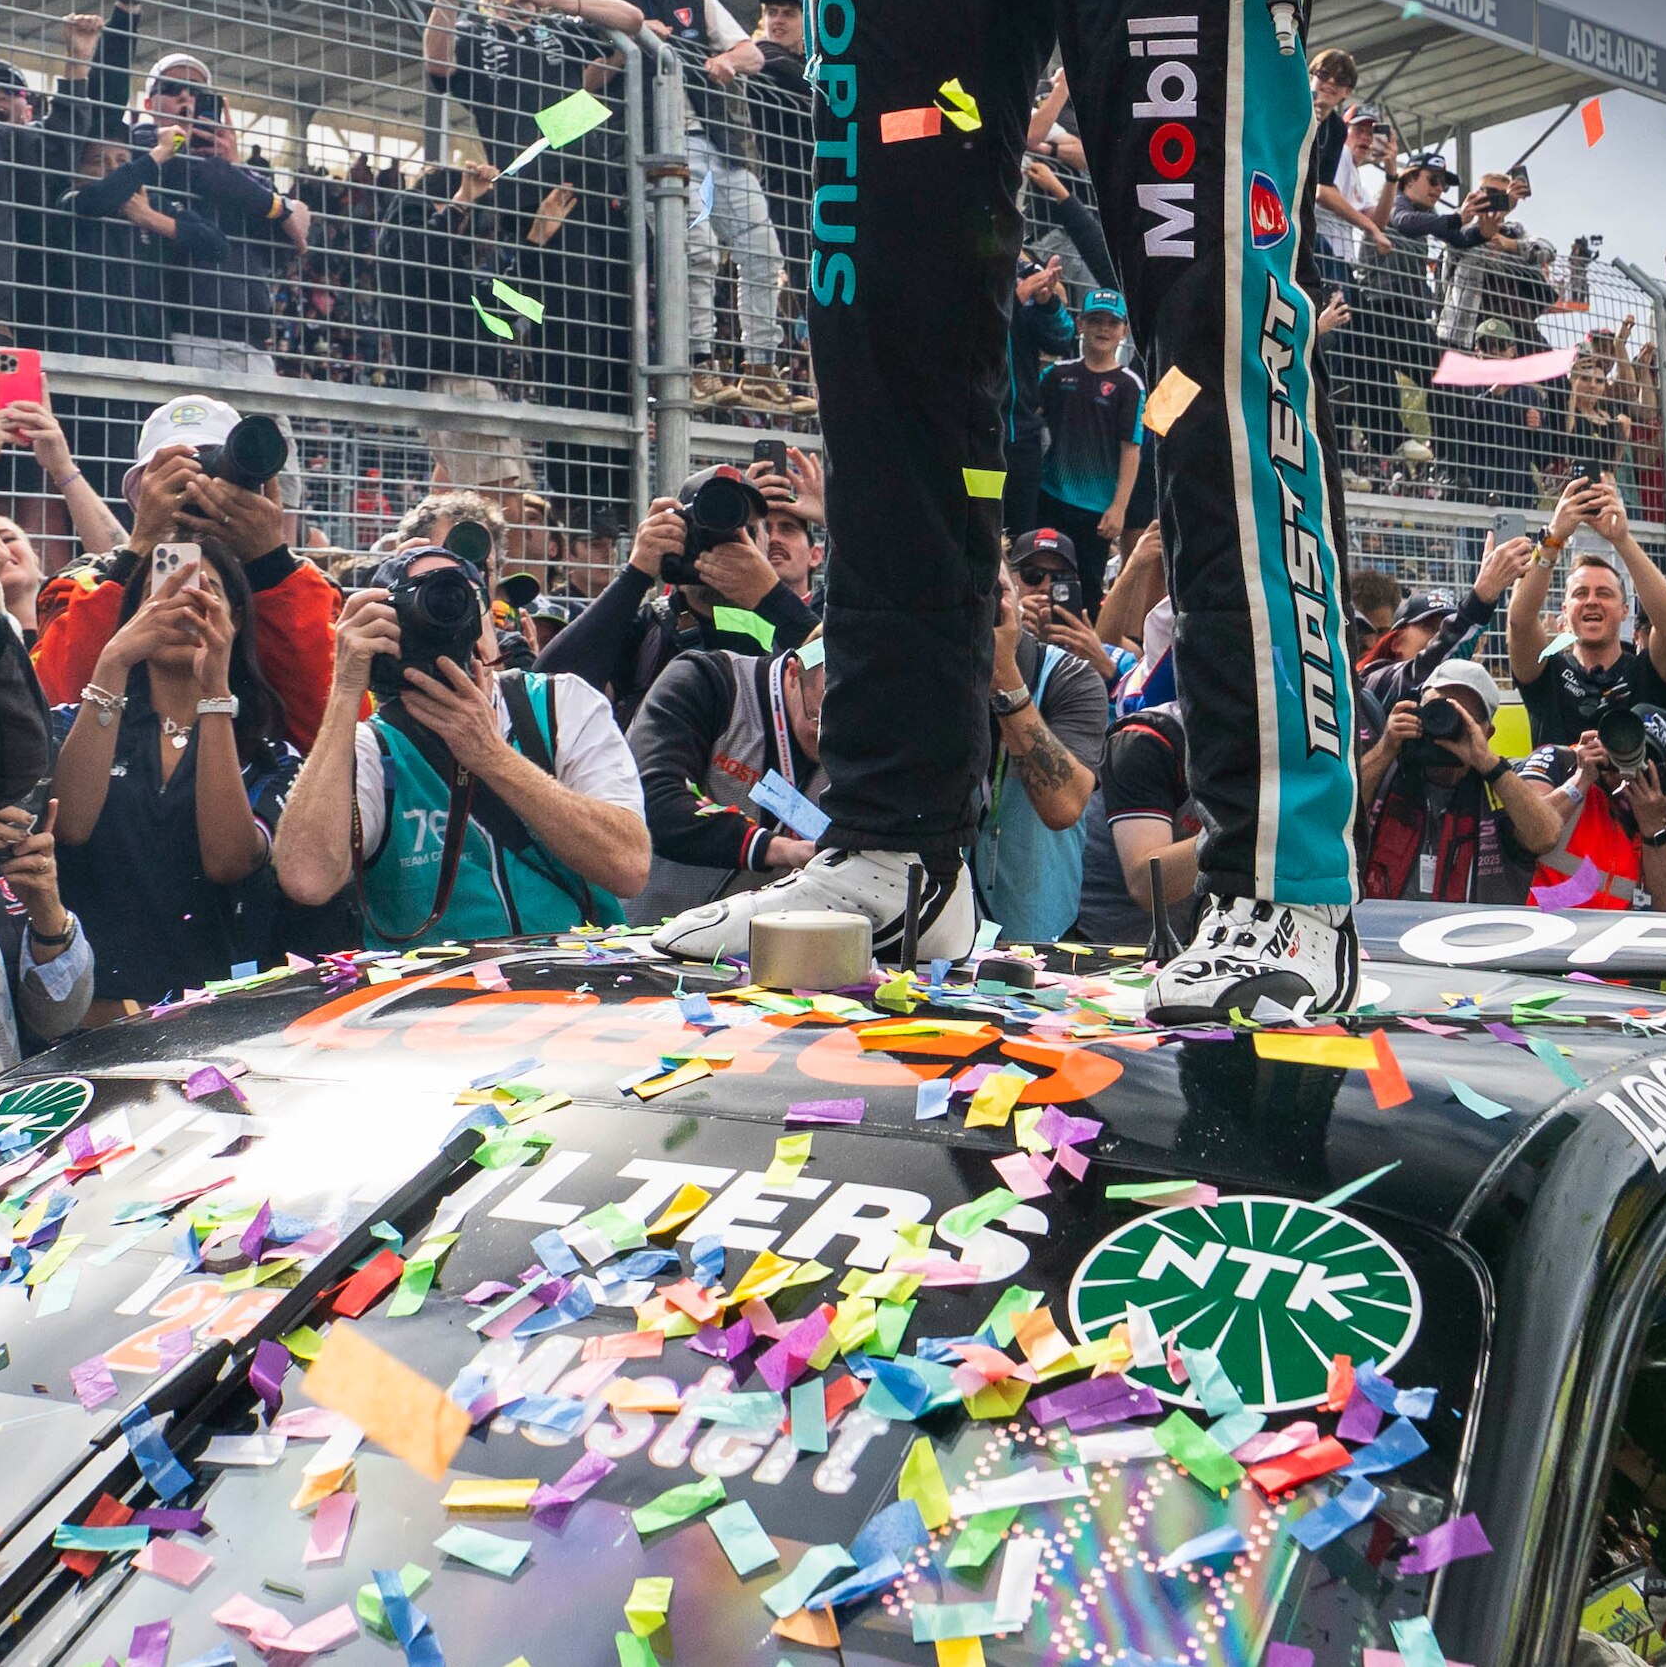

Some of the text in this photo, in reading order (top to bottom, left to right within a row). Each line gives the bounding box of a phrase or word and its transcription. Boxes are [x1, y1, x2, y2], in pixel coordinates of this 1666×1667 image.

[1566, 18, 1659, 87] ADELAIDE
[1127, 15, 1200, 259] Mobil
[1258, 270, 1343, 763] MOSTERT
[712, 751, 762, 786] HOST
[399, 854, 429, 868] TEAM
[1138, 1234, 1370, 1321] NTK
